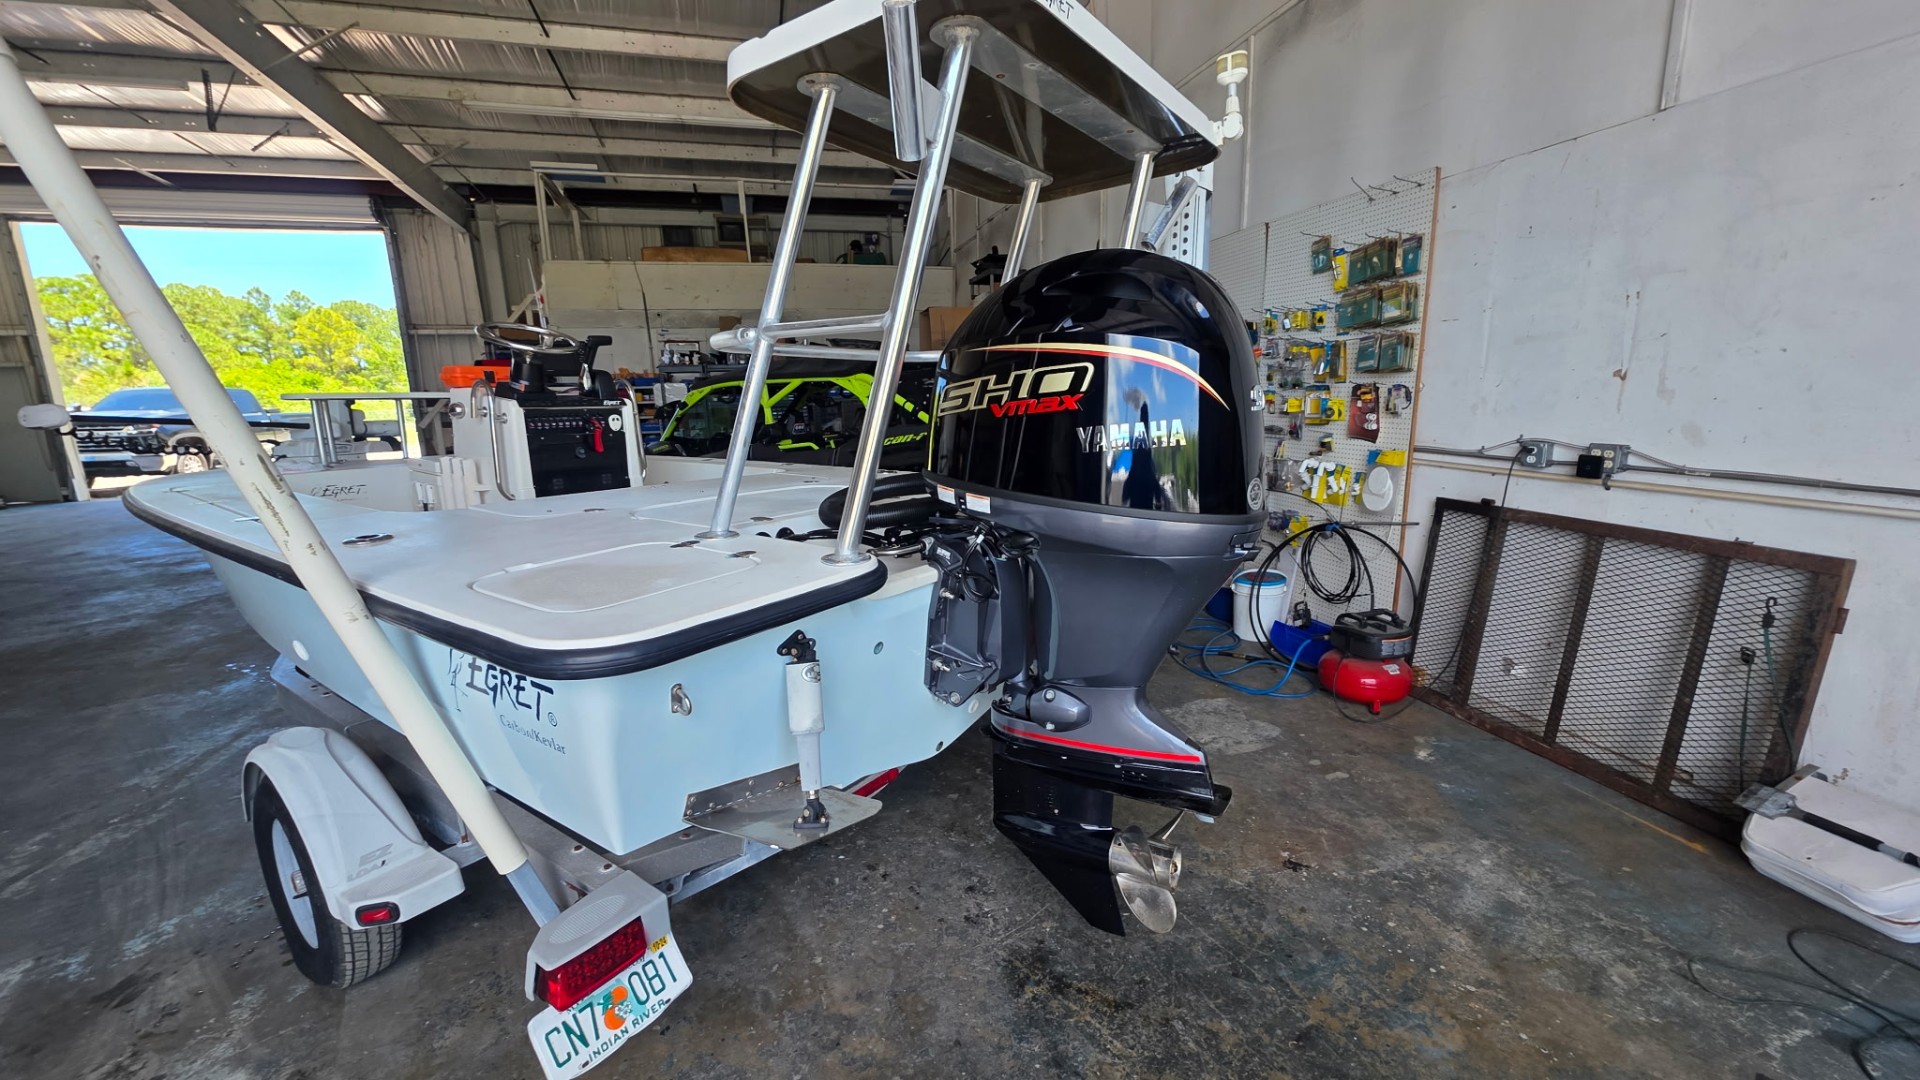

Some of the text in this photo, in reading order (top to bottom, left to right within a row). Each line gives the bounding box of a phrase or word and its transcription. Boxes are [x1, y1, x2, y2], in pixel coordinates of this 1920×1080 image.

[937, 362, 1095, 417] SHO
[1076, 419, 1187, 453] YAMAHA
[544, 1002, 601, 1068] CN7
[588, 999, 666, 1062] INDIAN RIVER
